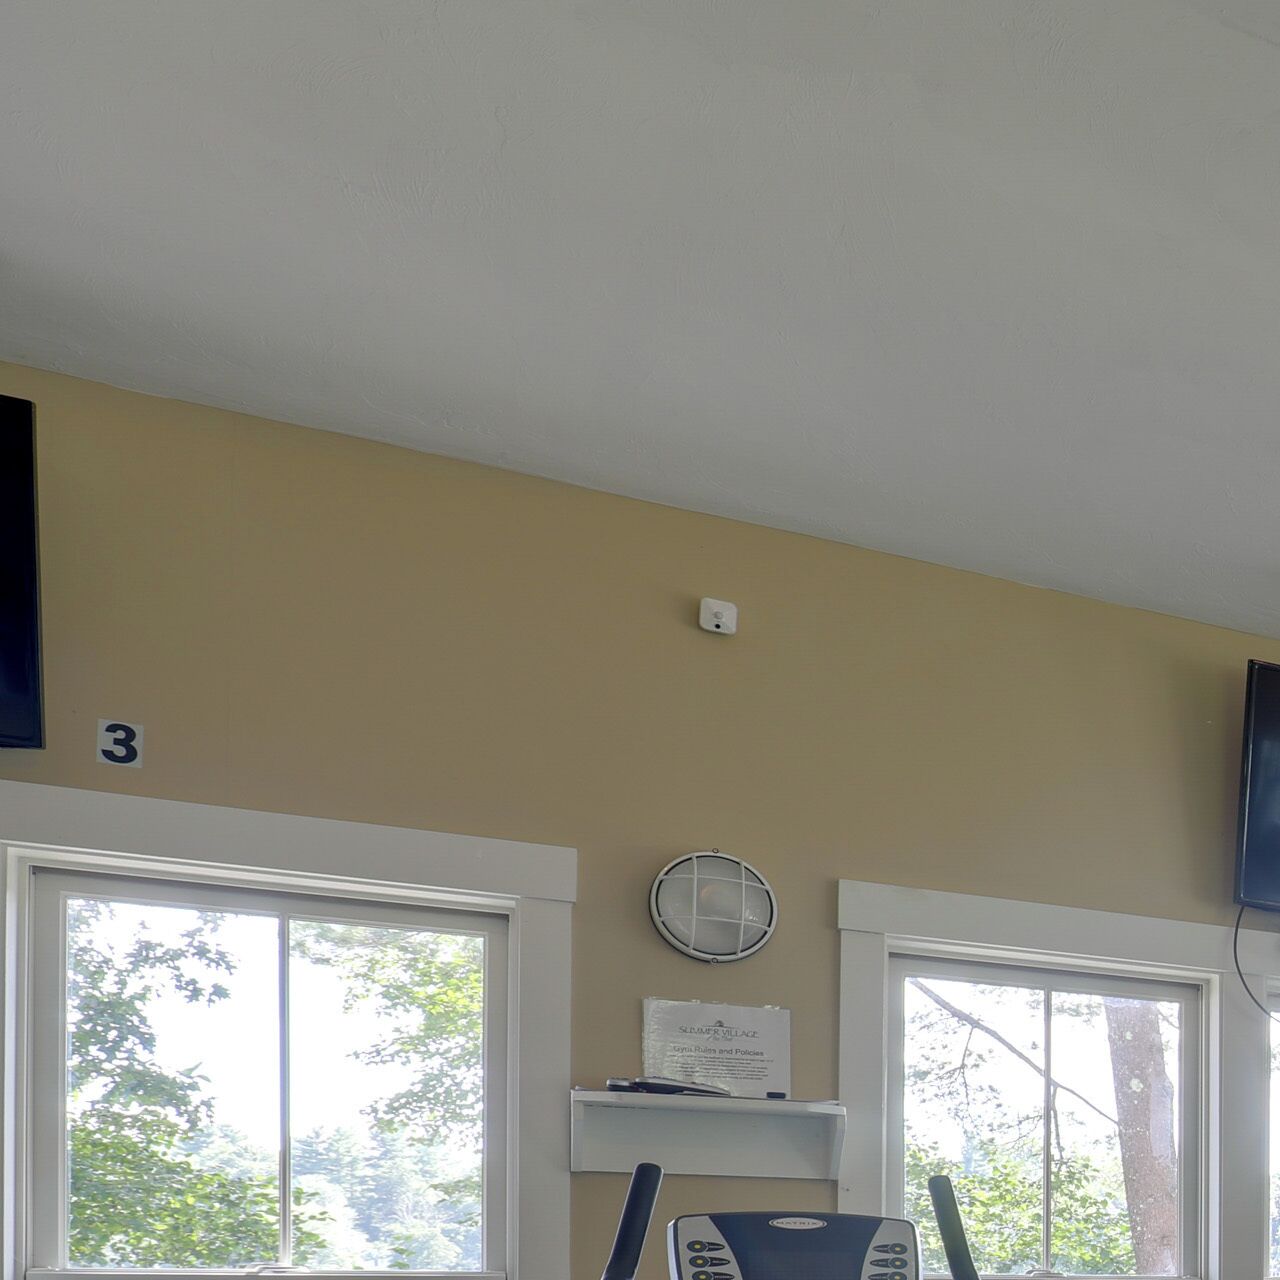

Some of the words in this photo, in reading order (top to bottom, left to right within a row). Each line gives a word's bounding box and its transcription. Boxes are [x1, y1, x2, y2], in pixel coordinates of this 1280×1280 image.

[101, 723, 138, 764] 3
[721, 1028, 760, 1039] VILLAGE
[719, 1047, 733, 1055] and
[735, 1048, 764, 1057] Policies
